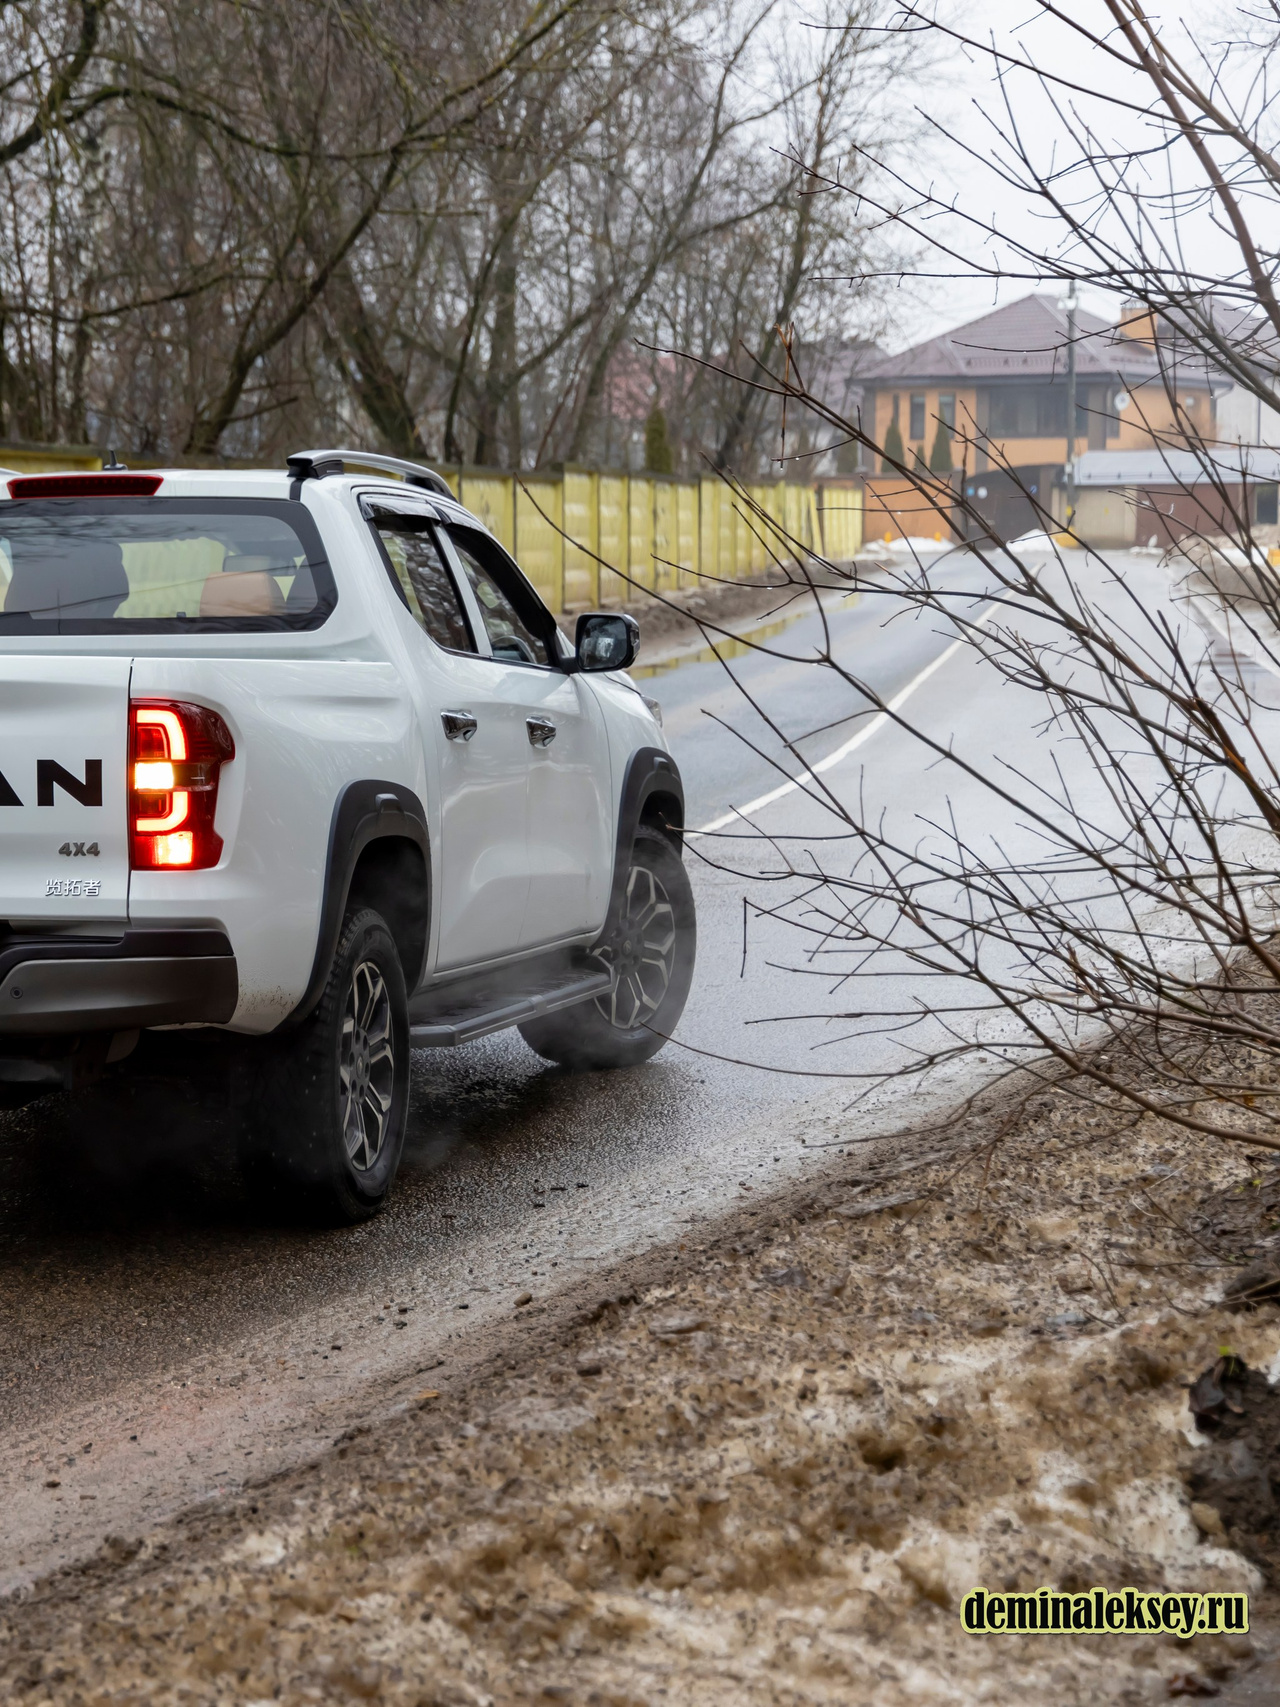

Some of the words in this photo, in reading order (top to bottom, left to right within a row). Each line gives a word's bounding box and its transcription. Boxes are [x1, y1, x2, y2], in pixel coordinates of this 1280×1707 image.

[58, 842, 100, 857] 4X4
[45, 878, 101, 897] 览拓者
